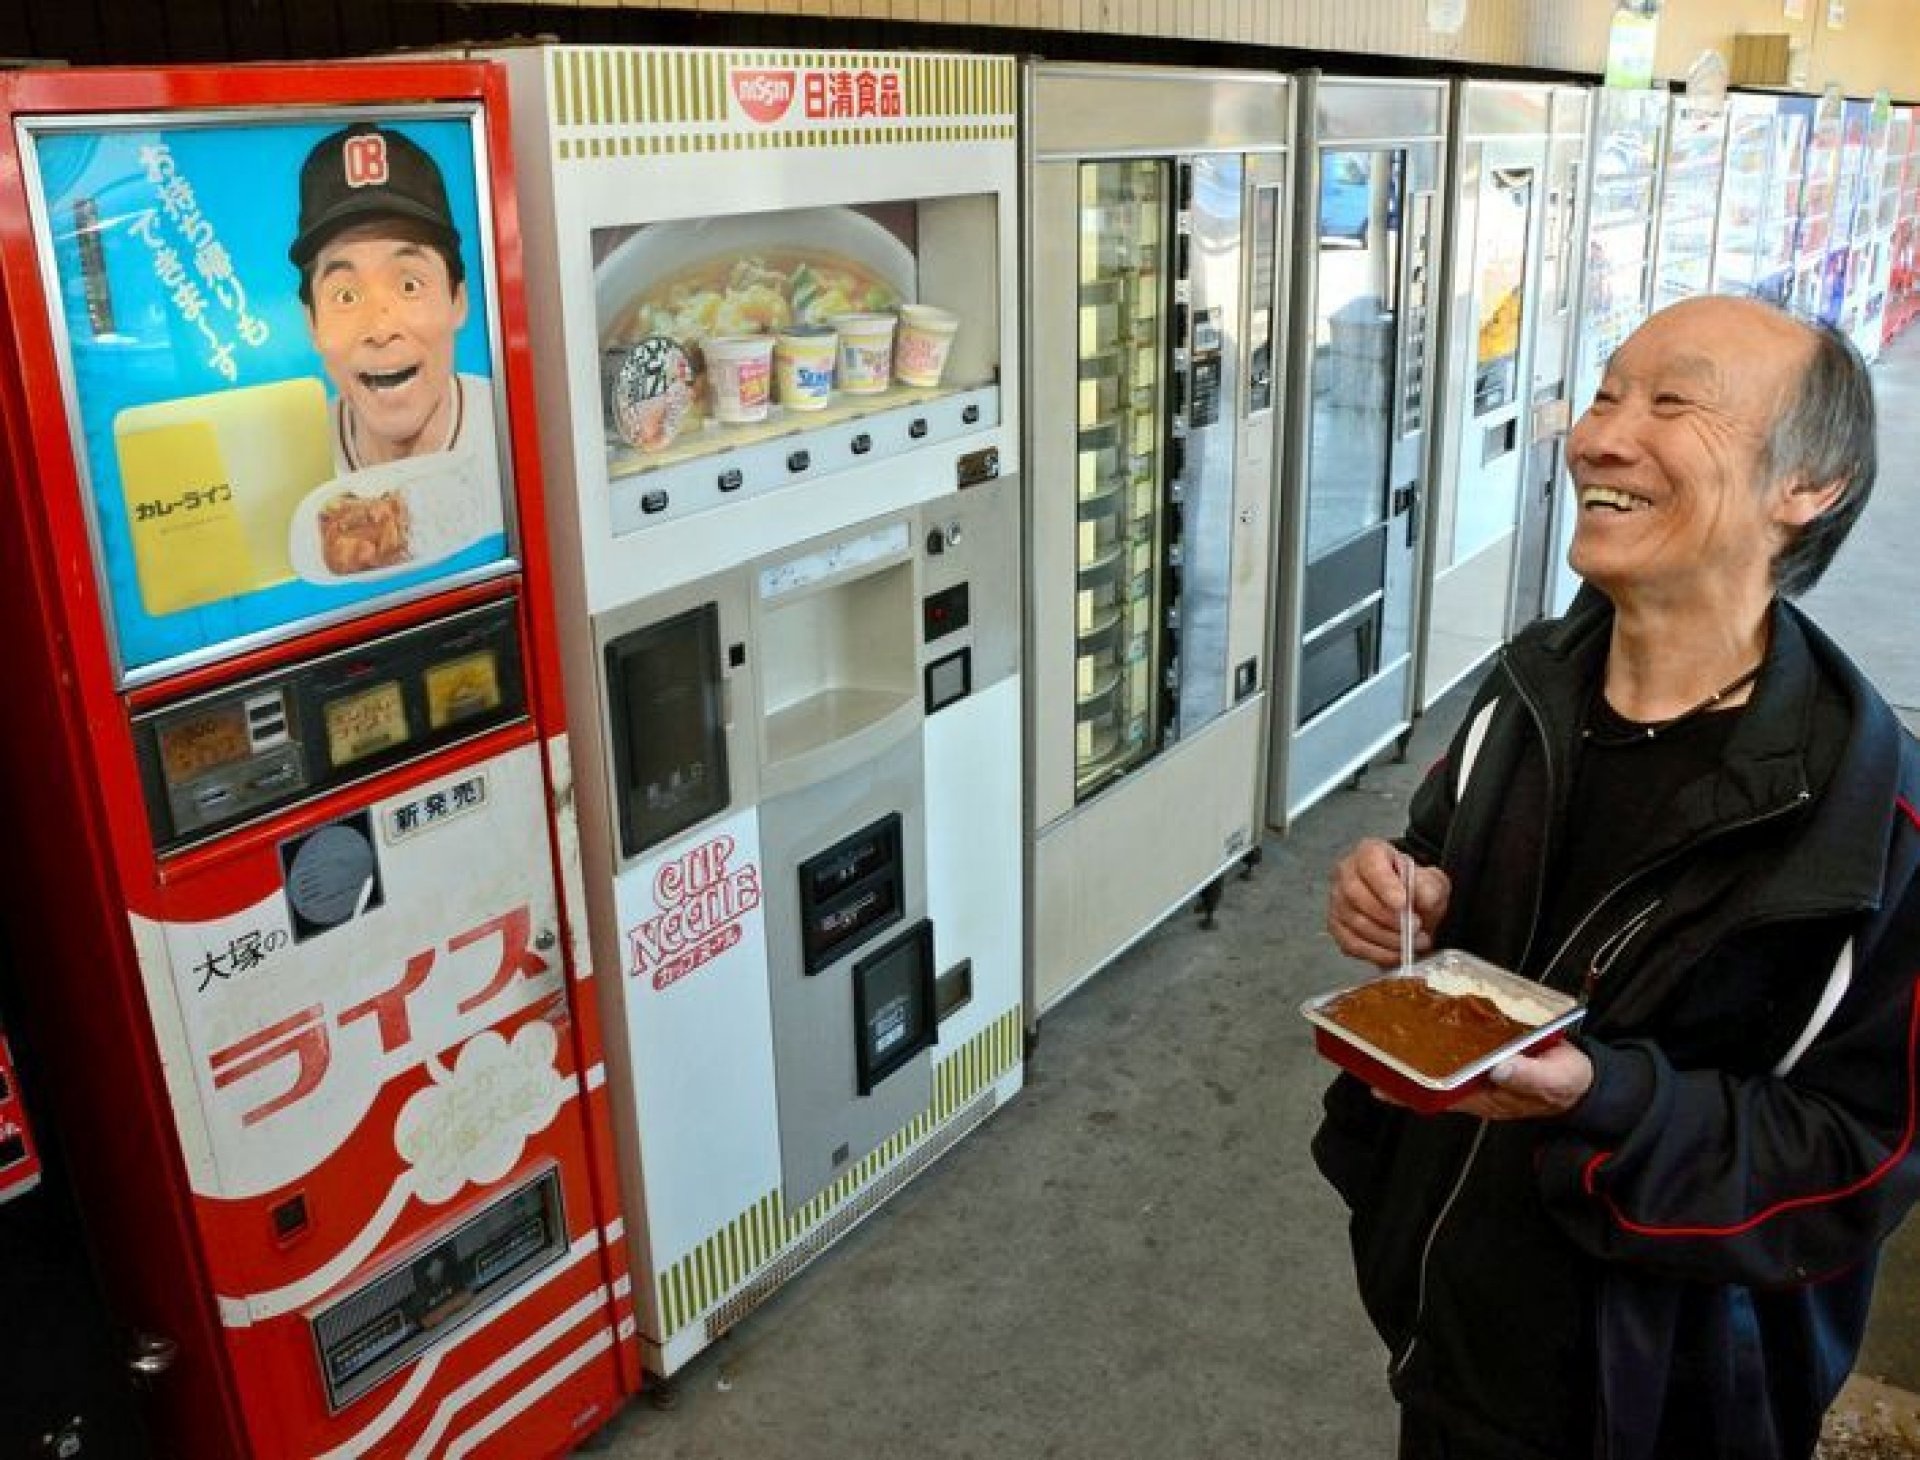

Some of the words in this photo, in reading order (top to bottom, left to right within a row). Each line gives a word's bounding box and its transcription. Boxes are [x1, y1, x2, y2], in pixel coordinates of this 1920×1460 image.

[804, 71, 900, 118] 日清食品
[396, 779, 477, 833] 新発売
[193, 929, 288, 992] 大塚の
[209, 905, 548, 1128] ライス
